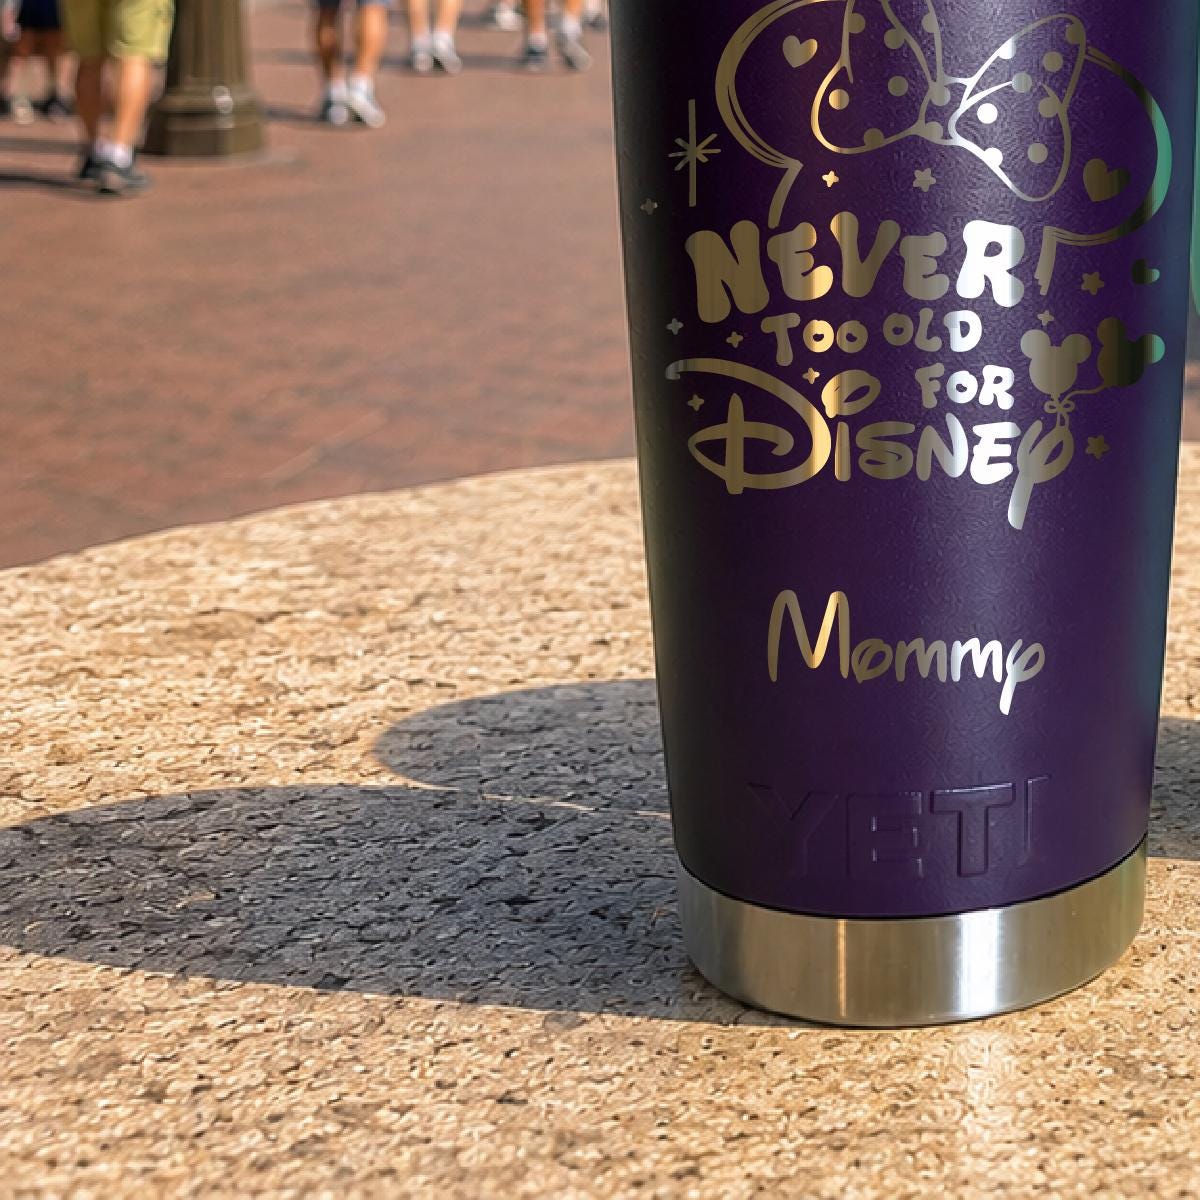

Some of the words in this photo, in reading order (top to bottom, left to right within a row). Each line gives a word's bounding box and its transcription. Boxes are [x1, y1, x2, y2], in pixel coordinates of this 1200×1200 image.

[685, 211, 1025, 323] NEVER
[760, 312, 868, 367] TOO
[883, 307, 983, 353] OLD
[915, 362, 1015, 410] FOR
[767, 589, 1046, 716] Mommy
[746, 773, 1053, 879] YETI
